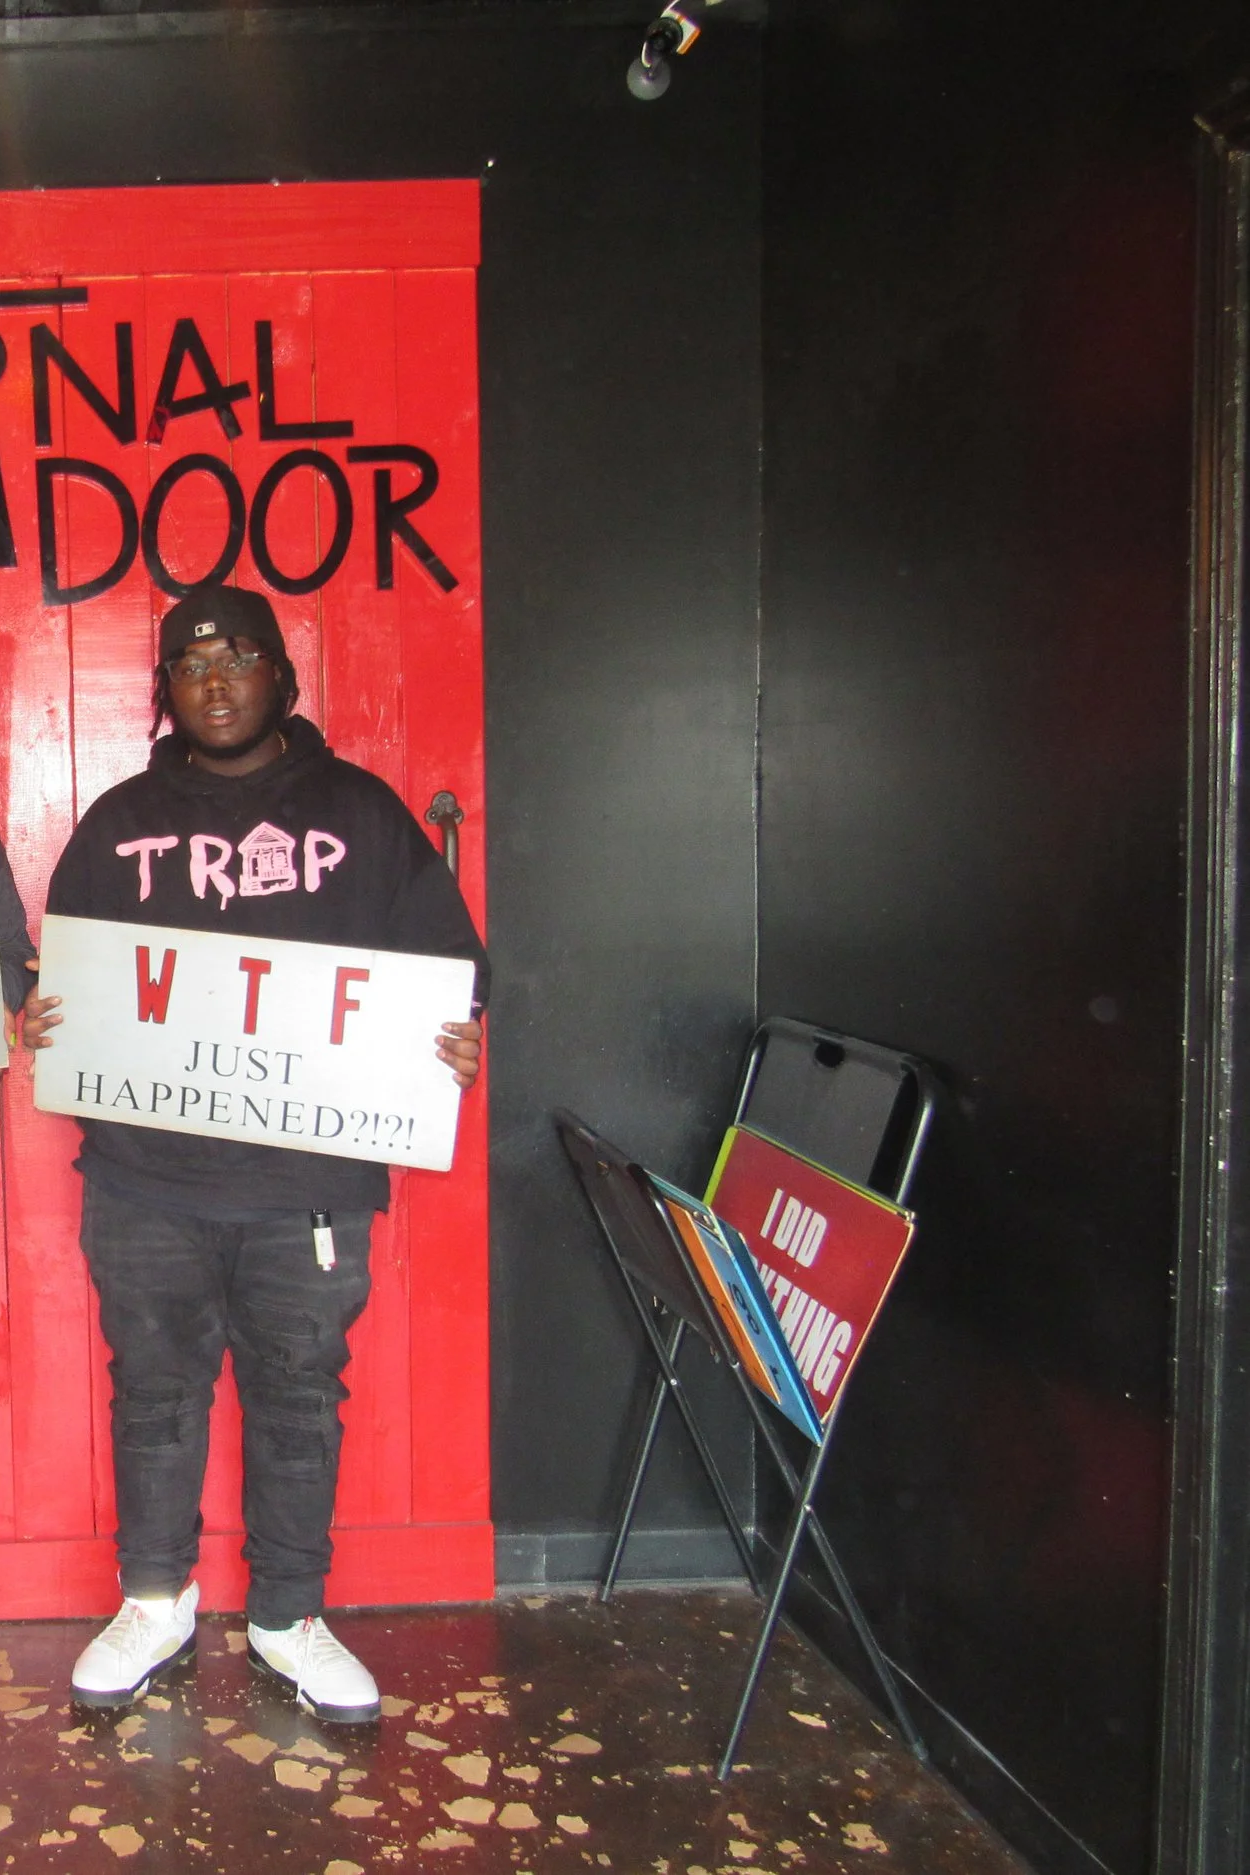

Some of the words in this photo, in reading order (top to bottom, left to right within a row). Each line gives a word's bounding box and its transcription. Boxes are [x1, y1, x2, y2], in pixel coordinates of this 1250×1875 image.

[35, 445, 460, 606] DOOR
[115, 821, 346, 910] TRAP
[184, 1041, 303, 1086] JUST
[74, 1071, 415, 1150] HAPPENED?!?!
[760, 1188, 784, 1238] I
[772, 1196, 827, 1268] DID
